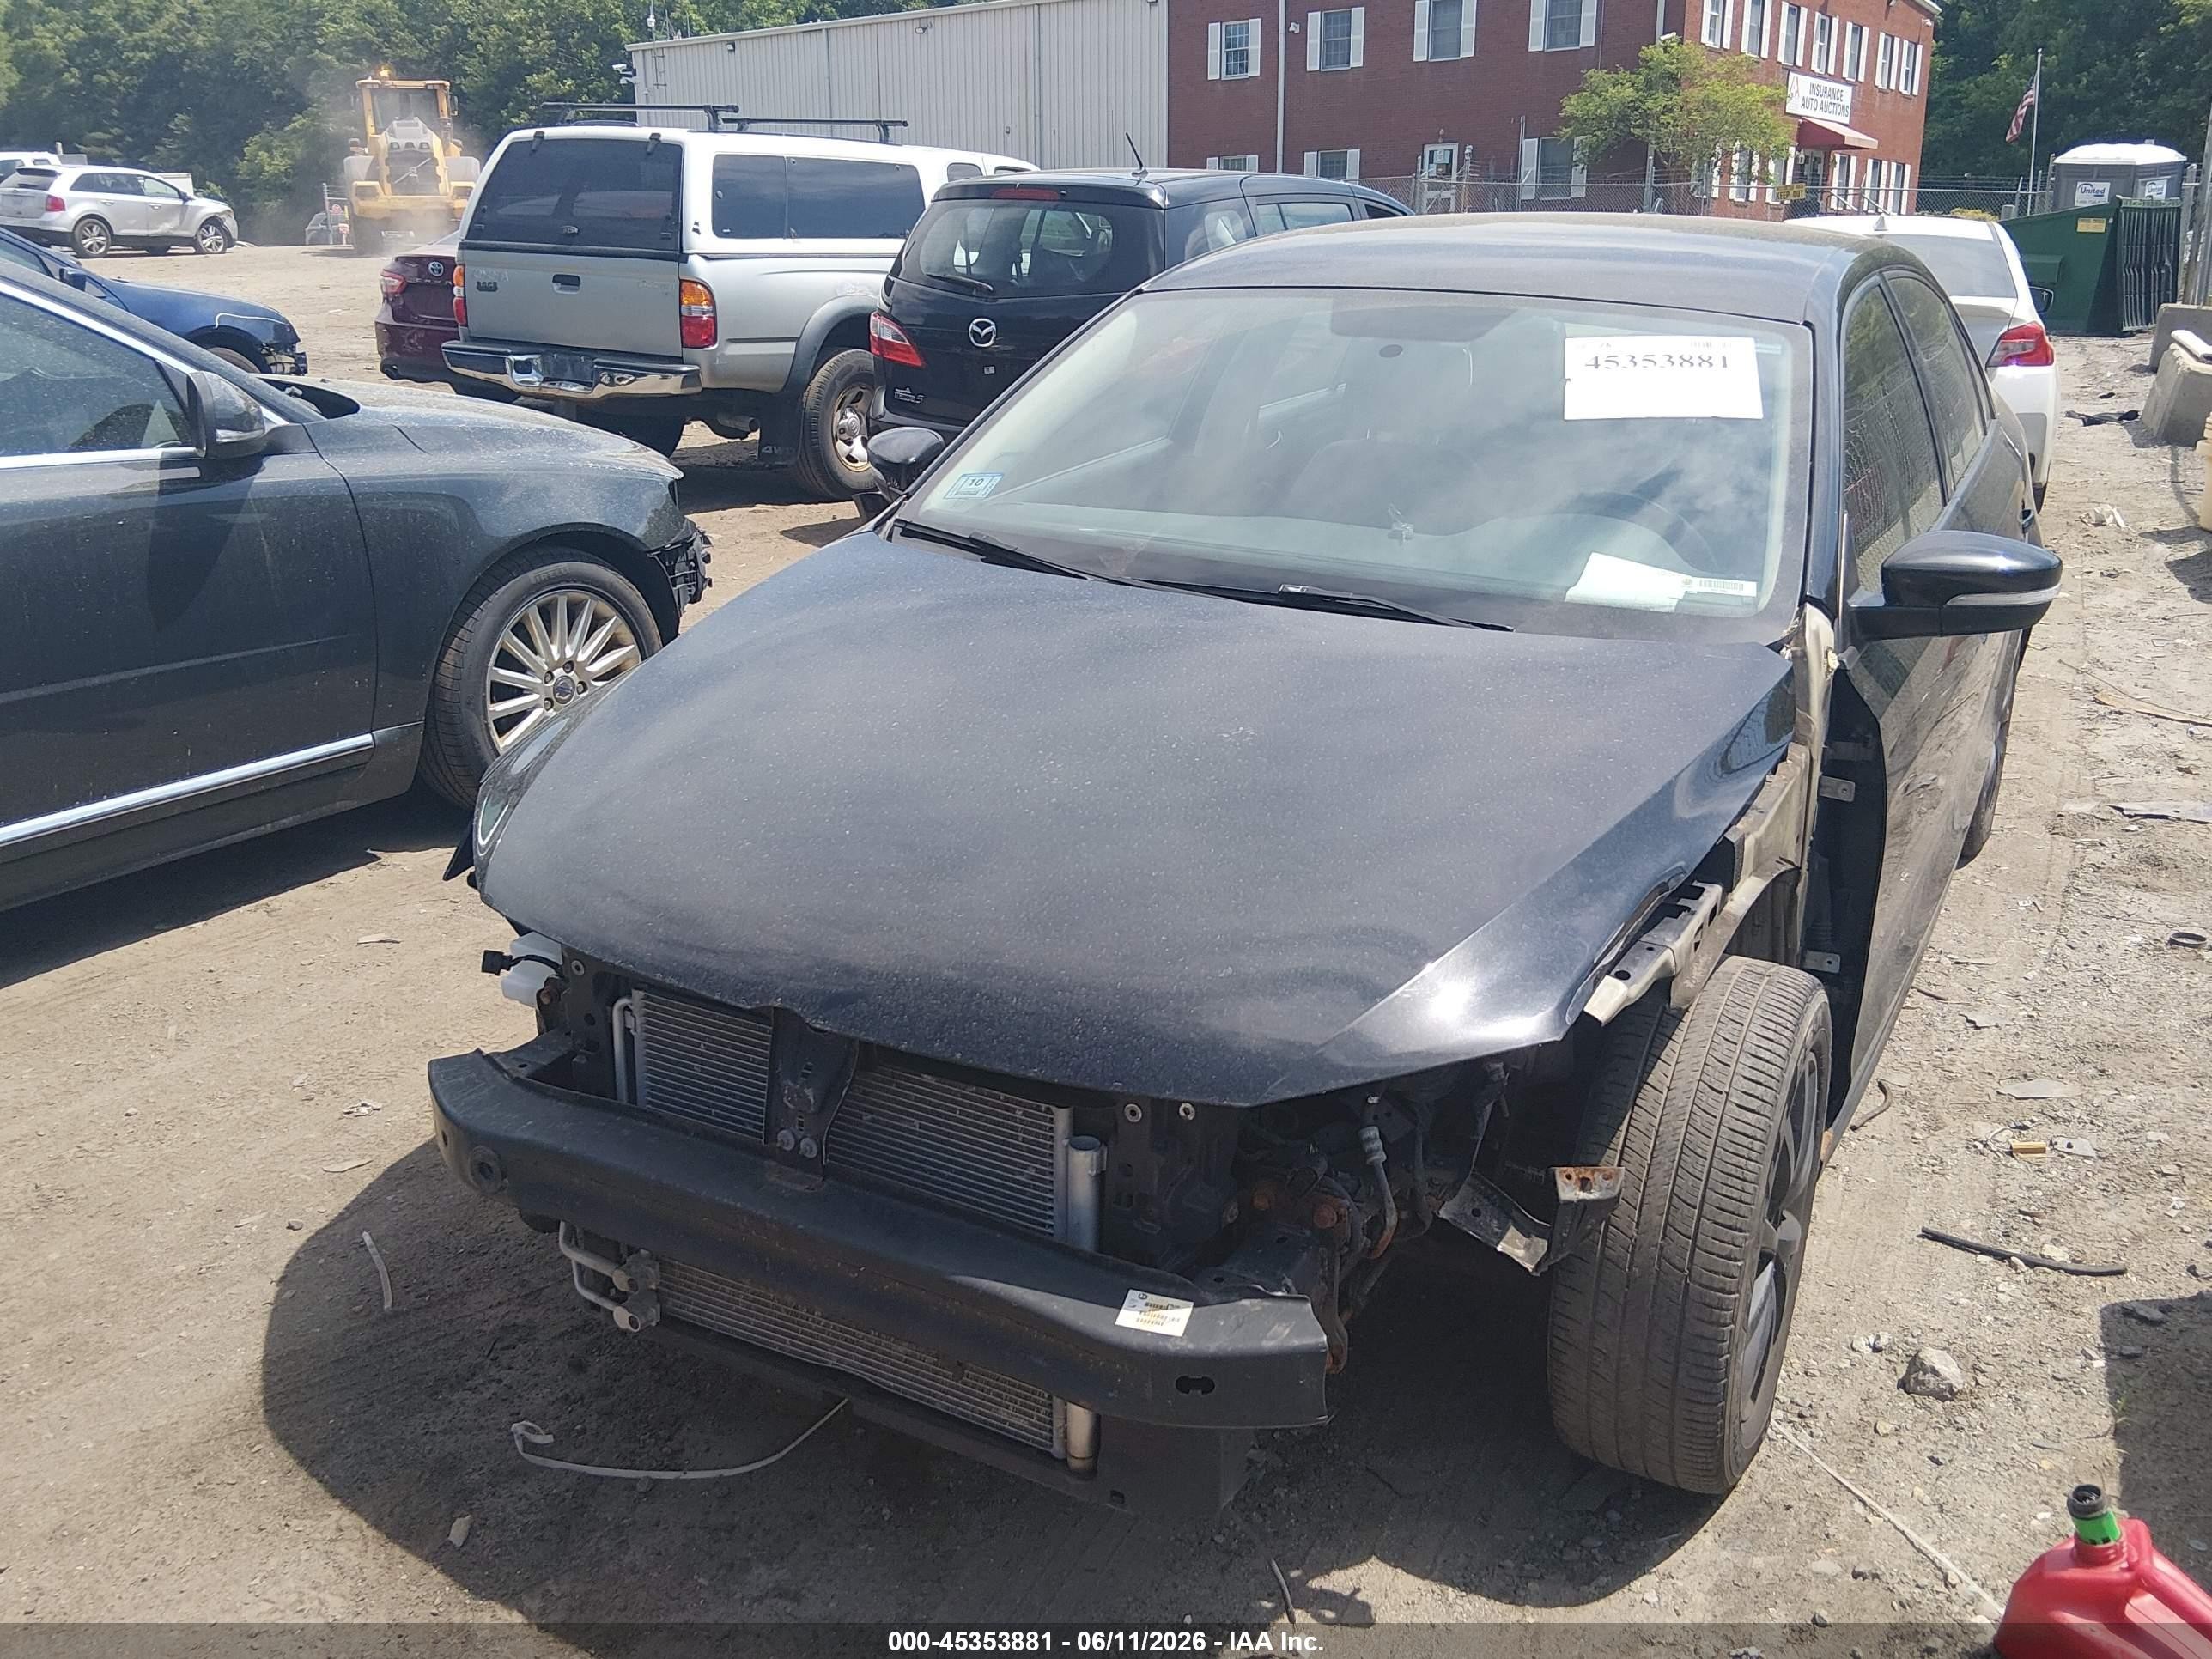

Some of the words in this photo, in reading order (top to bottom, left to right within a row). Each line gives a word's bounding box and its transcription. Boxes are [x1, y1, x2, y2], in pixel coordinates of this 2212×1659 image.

[1809, 82, 1844, 102] INSURANCE
[1801, 95, 1819, 111] AUTO
[1819, 100, 1850, 118] AUCTIONS
[1778, 191, 1790, 200] KEEP
[1793, 190, 1803, 198] OUT
[2080, 186, 2106, 195] United
[1584, 354, 1728, 369] 45353881
[969, 478, 984, 487] 10
